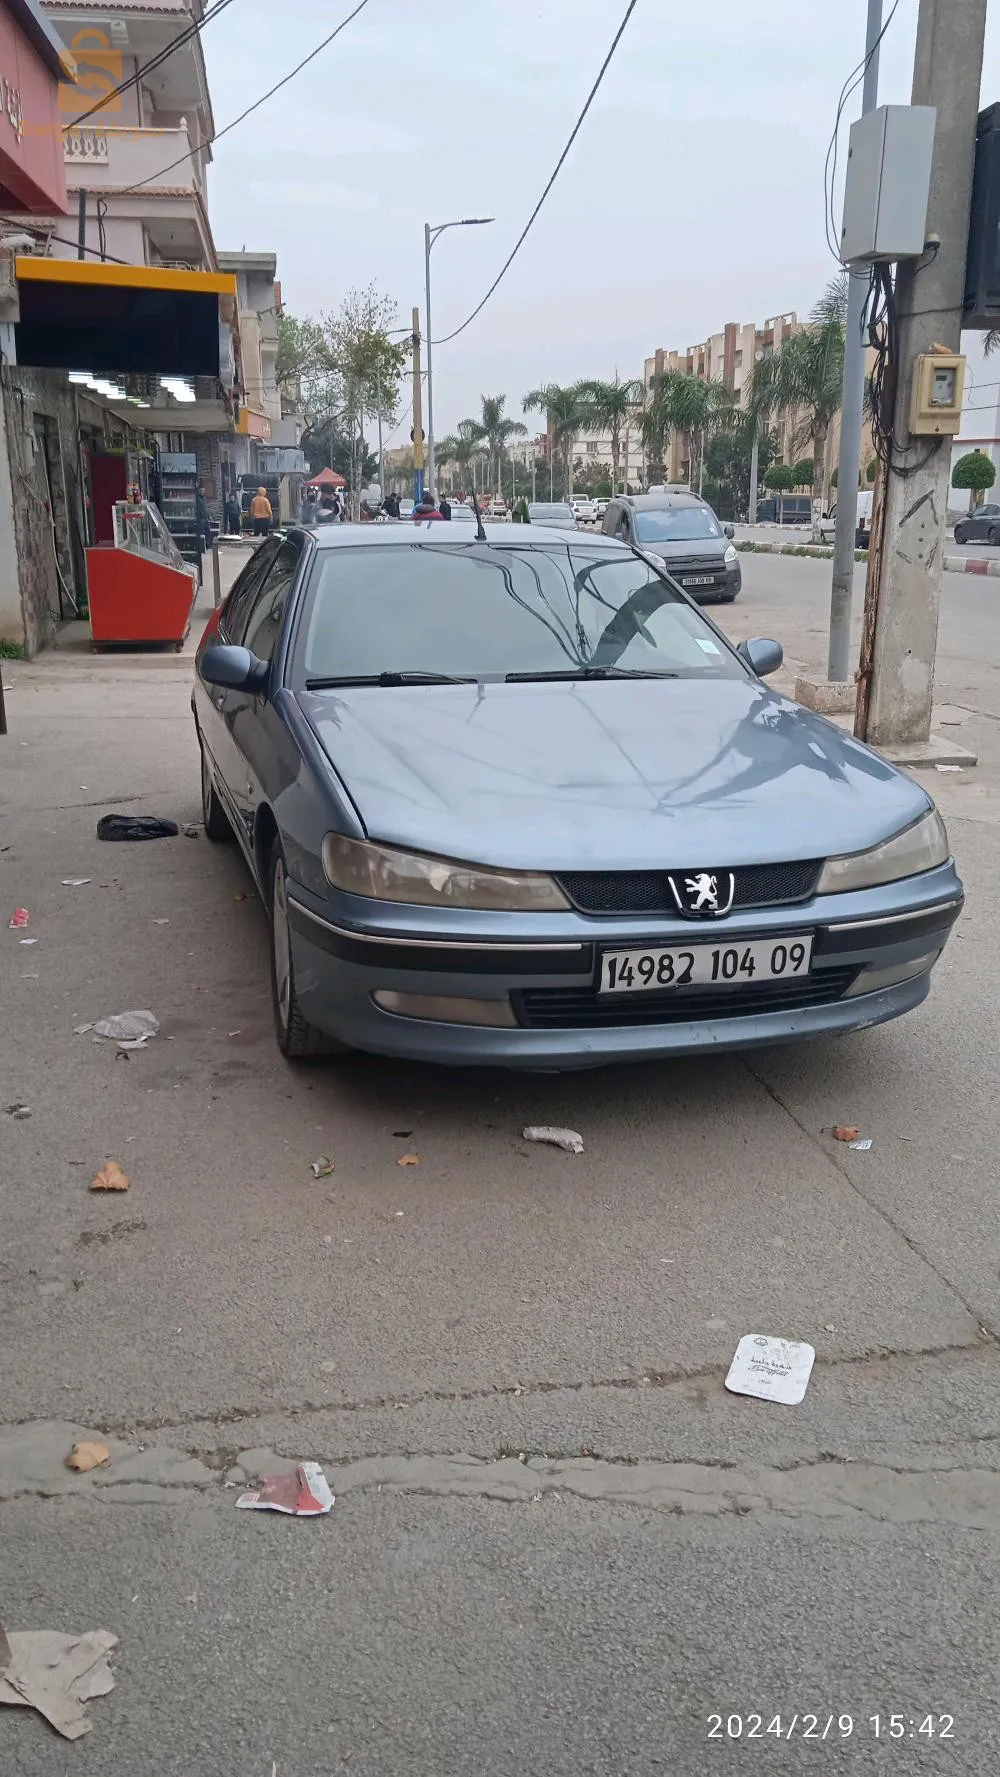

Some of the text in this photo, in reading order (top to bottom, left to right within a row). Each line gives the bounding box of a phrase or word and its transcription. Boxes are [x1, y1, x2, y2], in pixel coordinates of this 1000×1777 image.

[607, 943, 805, 989] 14982 104 09
